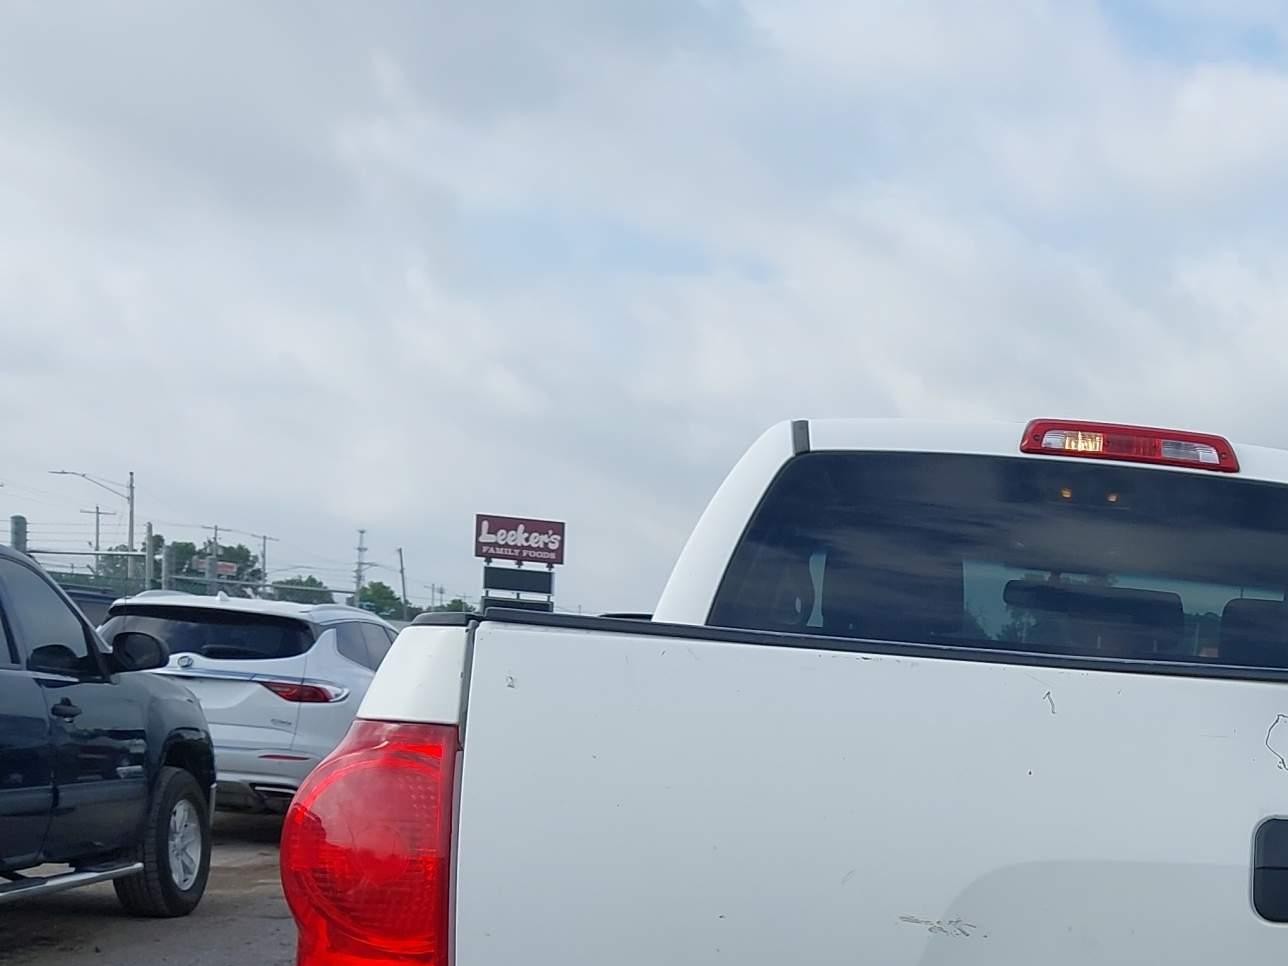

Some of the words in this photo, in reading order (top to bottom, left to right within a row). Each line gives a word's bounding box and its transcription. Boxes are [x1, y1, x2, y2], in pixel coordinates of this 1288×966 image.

[478, 519, 561, 550] Leeker's
[482, 545, 520, 556] FAMILY
[522, 549, 556, 559] FOODS
